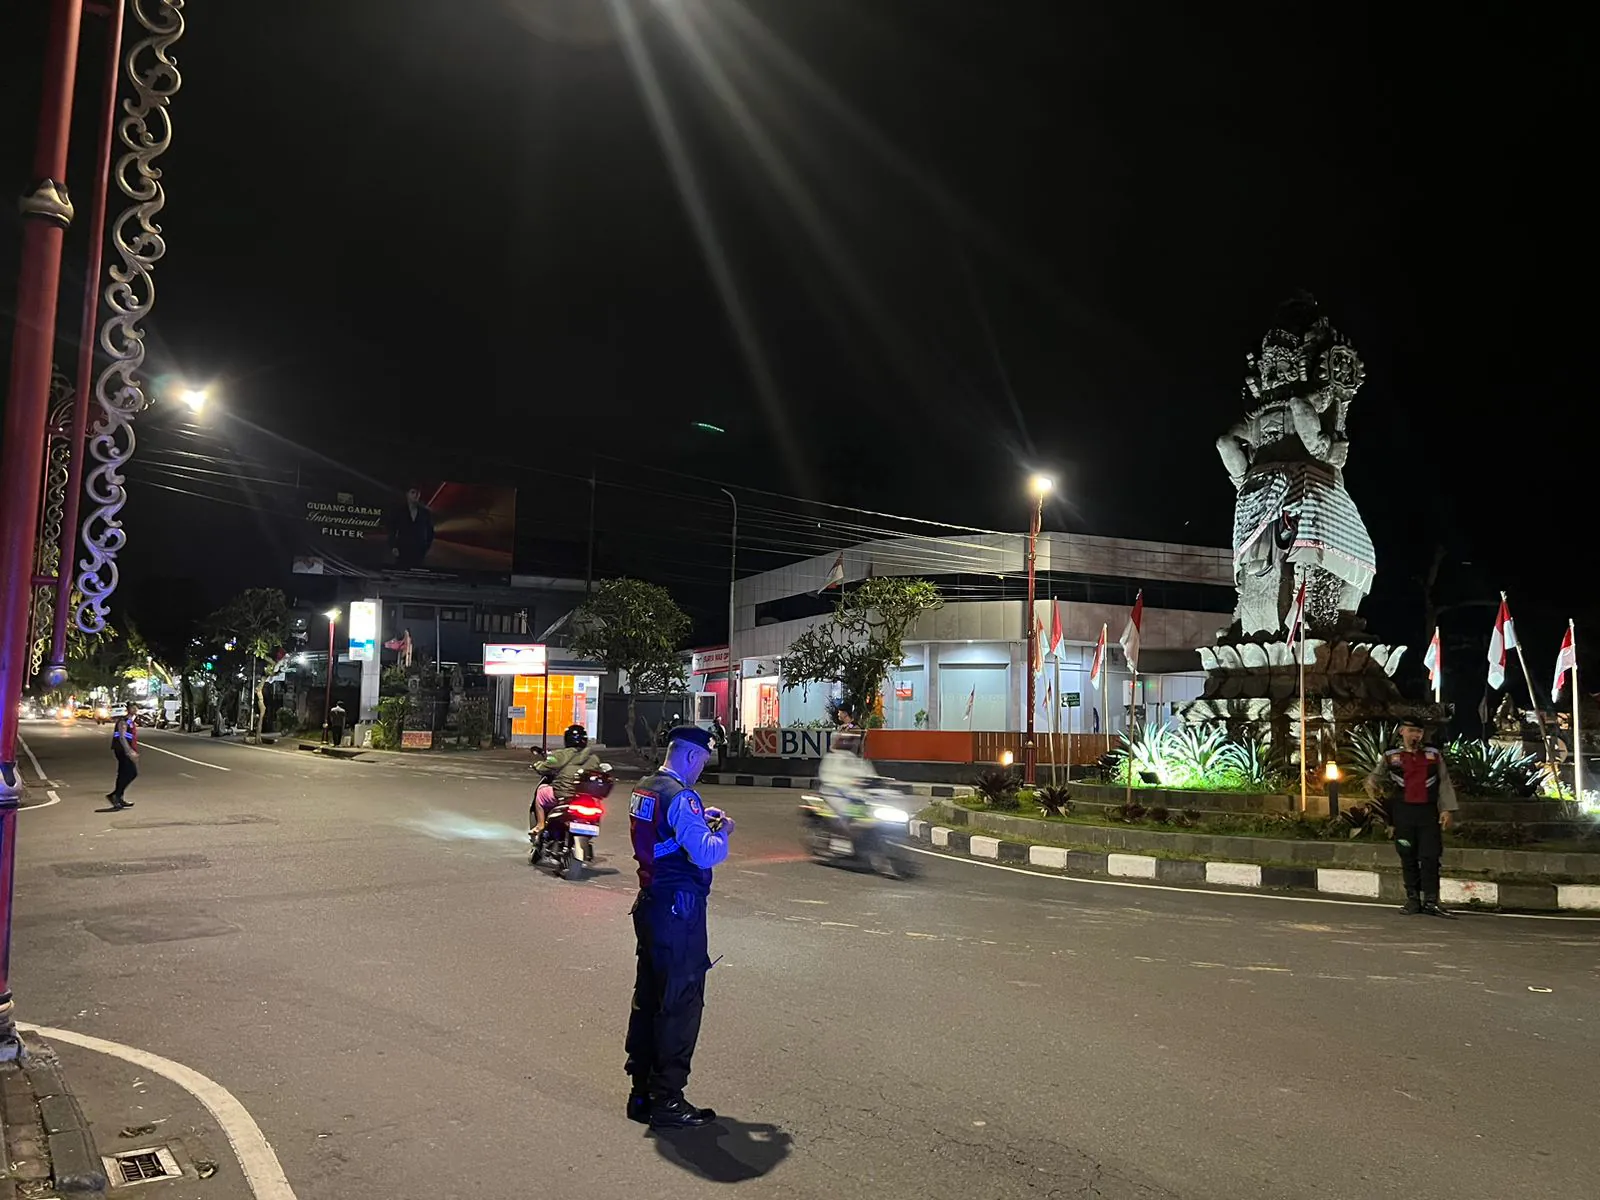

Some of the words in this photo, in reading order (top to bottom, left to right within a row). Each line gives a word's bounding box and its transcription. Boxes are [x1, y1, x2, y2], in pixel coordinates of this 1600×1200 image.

[306, 502, 346, 513] GUDANG
[347, 506, 382, 516] GARAM
[305, 511, 381, 527] International
[321, 527, 364, 539] FILTER
[781, 730, 832, 756] BNI
